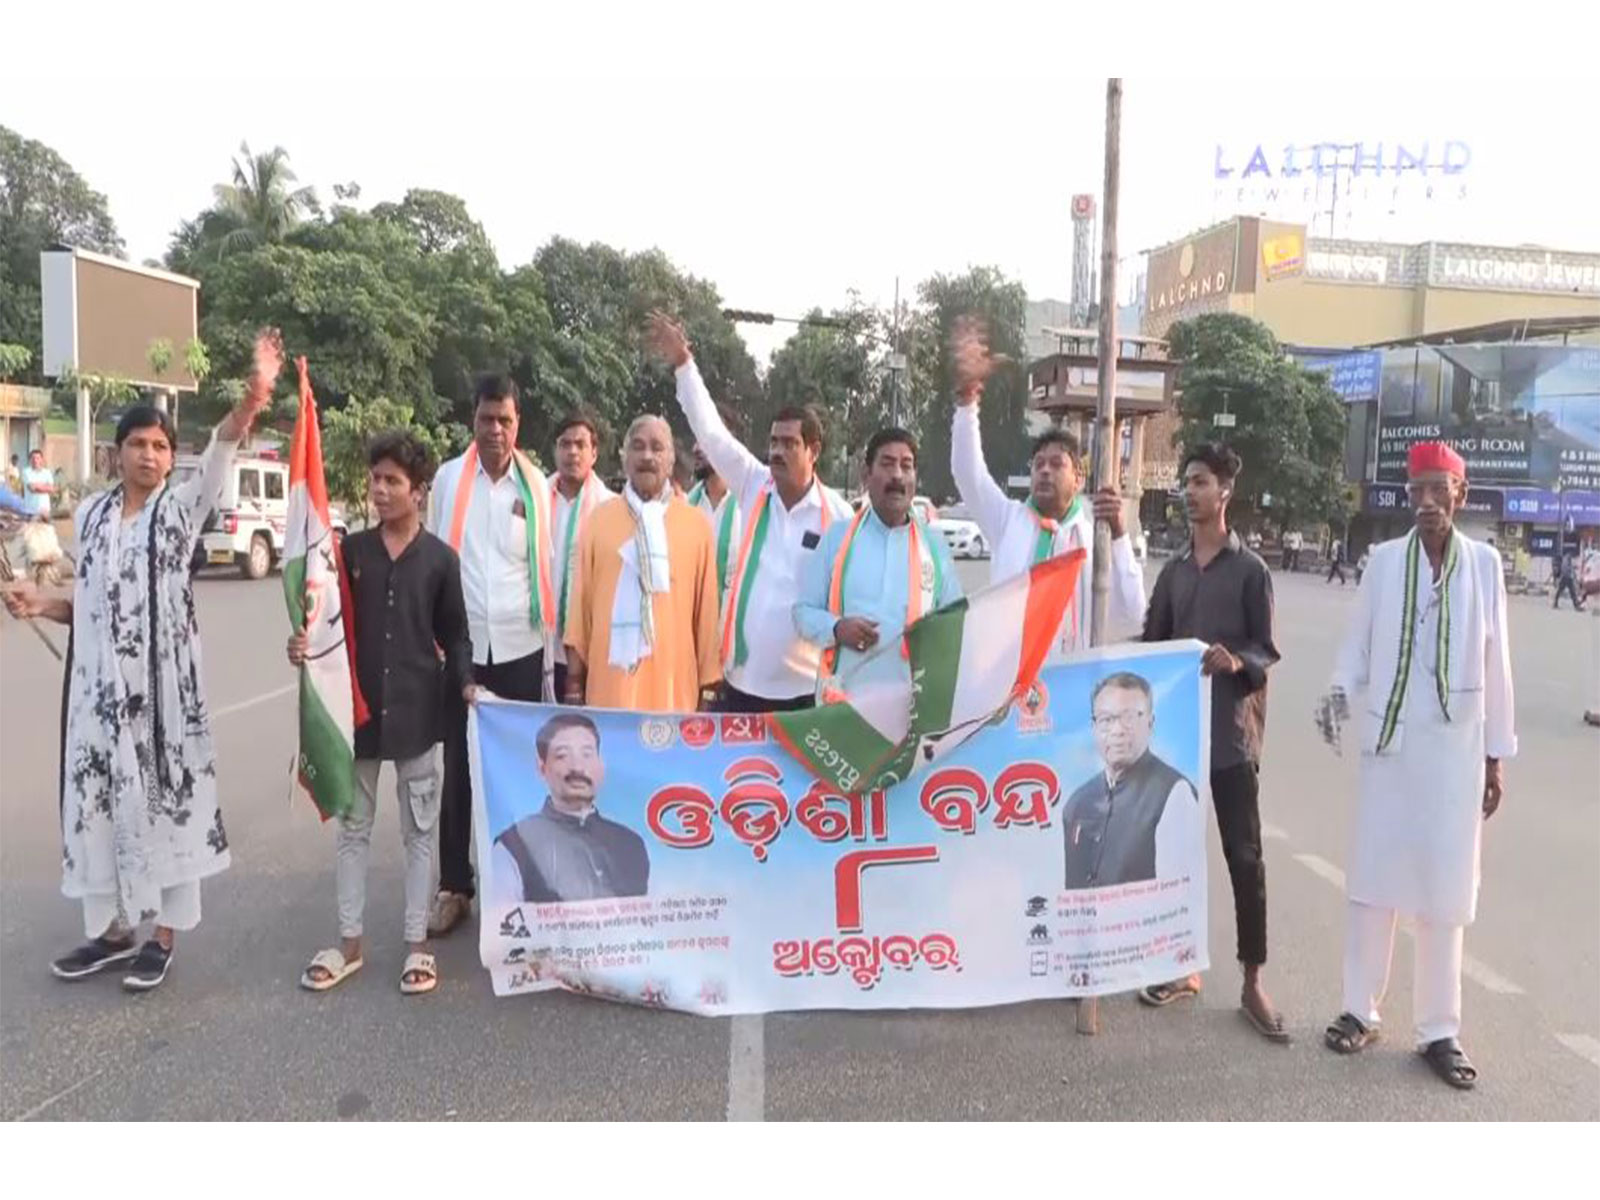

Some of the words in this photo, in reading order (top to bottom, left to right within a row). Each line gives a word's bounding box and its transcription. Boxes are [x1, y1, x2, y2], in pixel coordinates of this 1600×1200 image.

[1213, 142, 1472, 179] LALCHND
[1444, 255, 1539, 282] LALCHND
[1150, 271, 1226, 312] LALCHND
[1381, 424, 1440, 438] BALCONIES
[1481, 439, 1525, 453] ROOM
[1378, 490, 1396, 507] SBI
